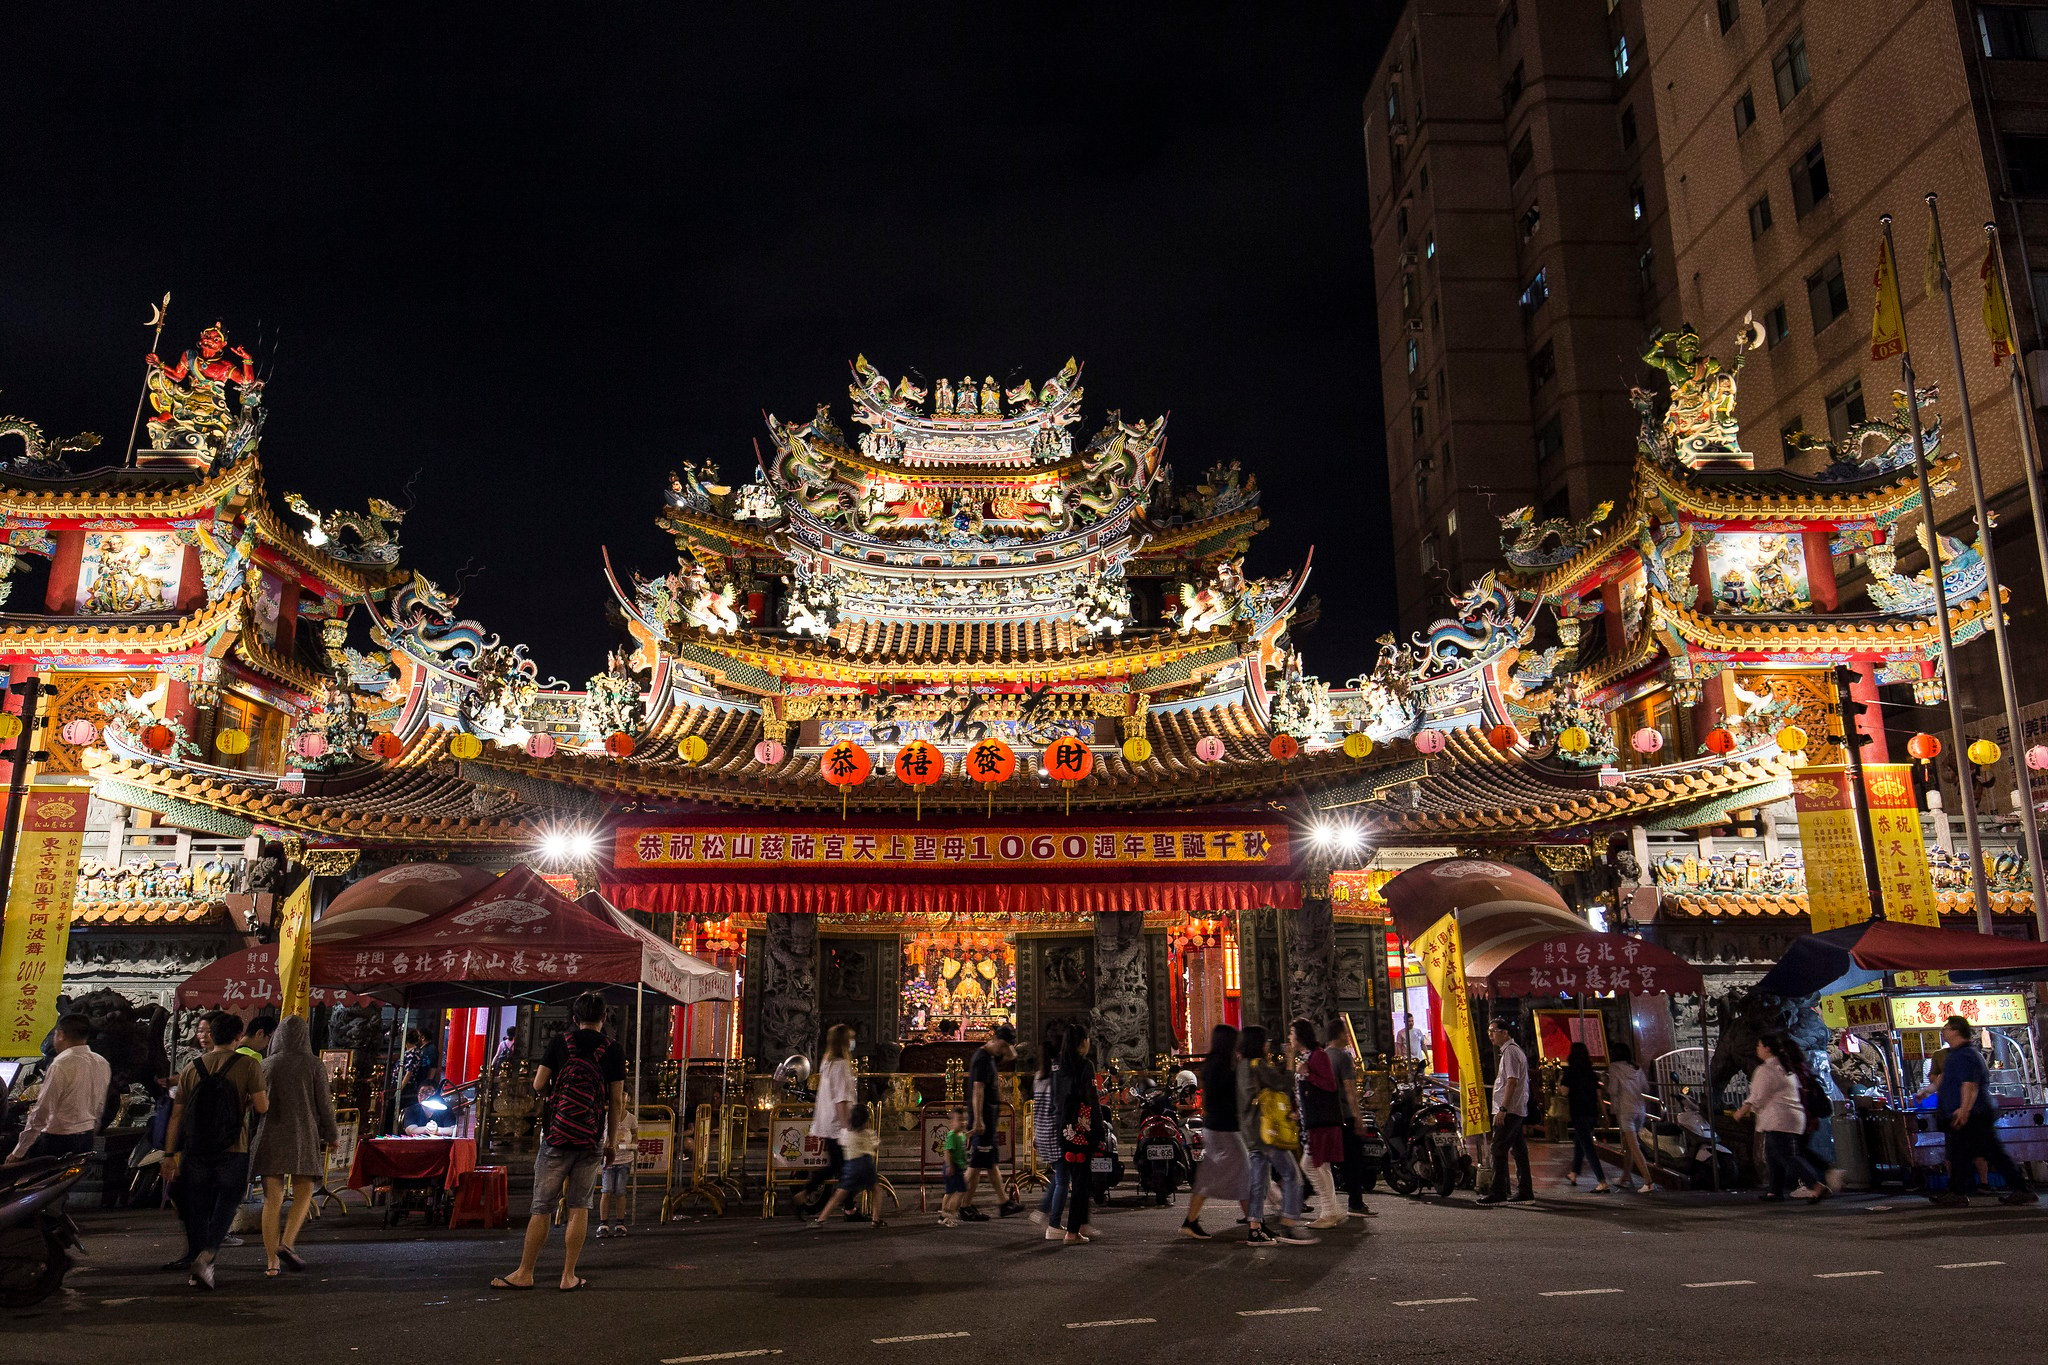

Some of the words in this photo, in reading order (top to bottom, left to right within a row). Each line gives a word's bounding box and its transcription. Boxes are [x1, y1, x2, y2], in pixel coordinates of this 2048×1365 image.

[829, 748, 859, 777] 恭
[900, 747, 933, 777] 禧
[973, 745, 1006, 775] 發
[1055, 744, 1088, 772] 財
[1877, 815, 1912, 835] 恭祝
[639, 832, 1269, 861] 恭祝松山慈祐宮天上聖母1060週年聖誕千秋
[1890, 840, 1919, 921] 天上聖母
[391, 949, 583, 976] 台北市松山慈祐宮
[1576, 941, 1641, 965] 台北市
[1529, 965, 1657, 989] 松山慈祐宮
